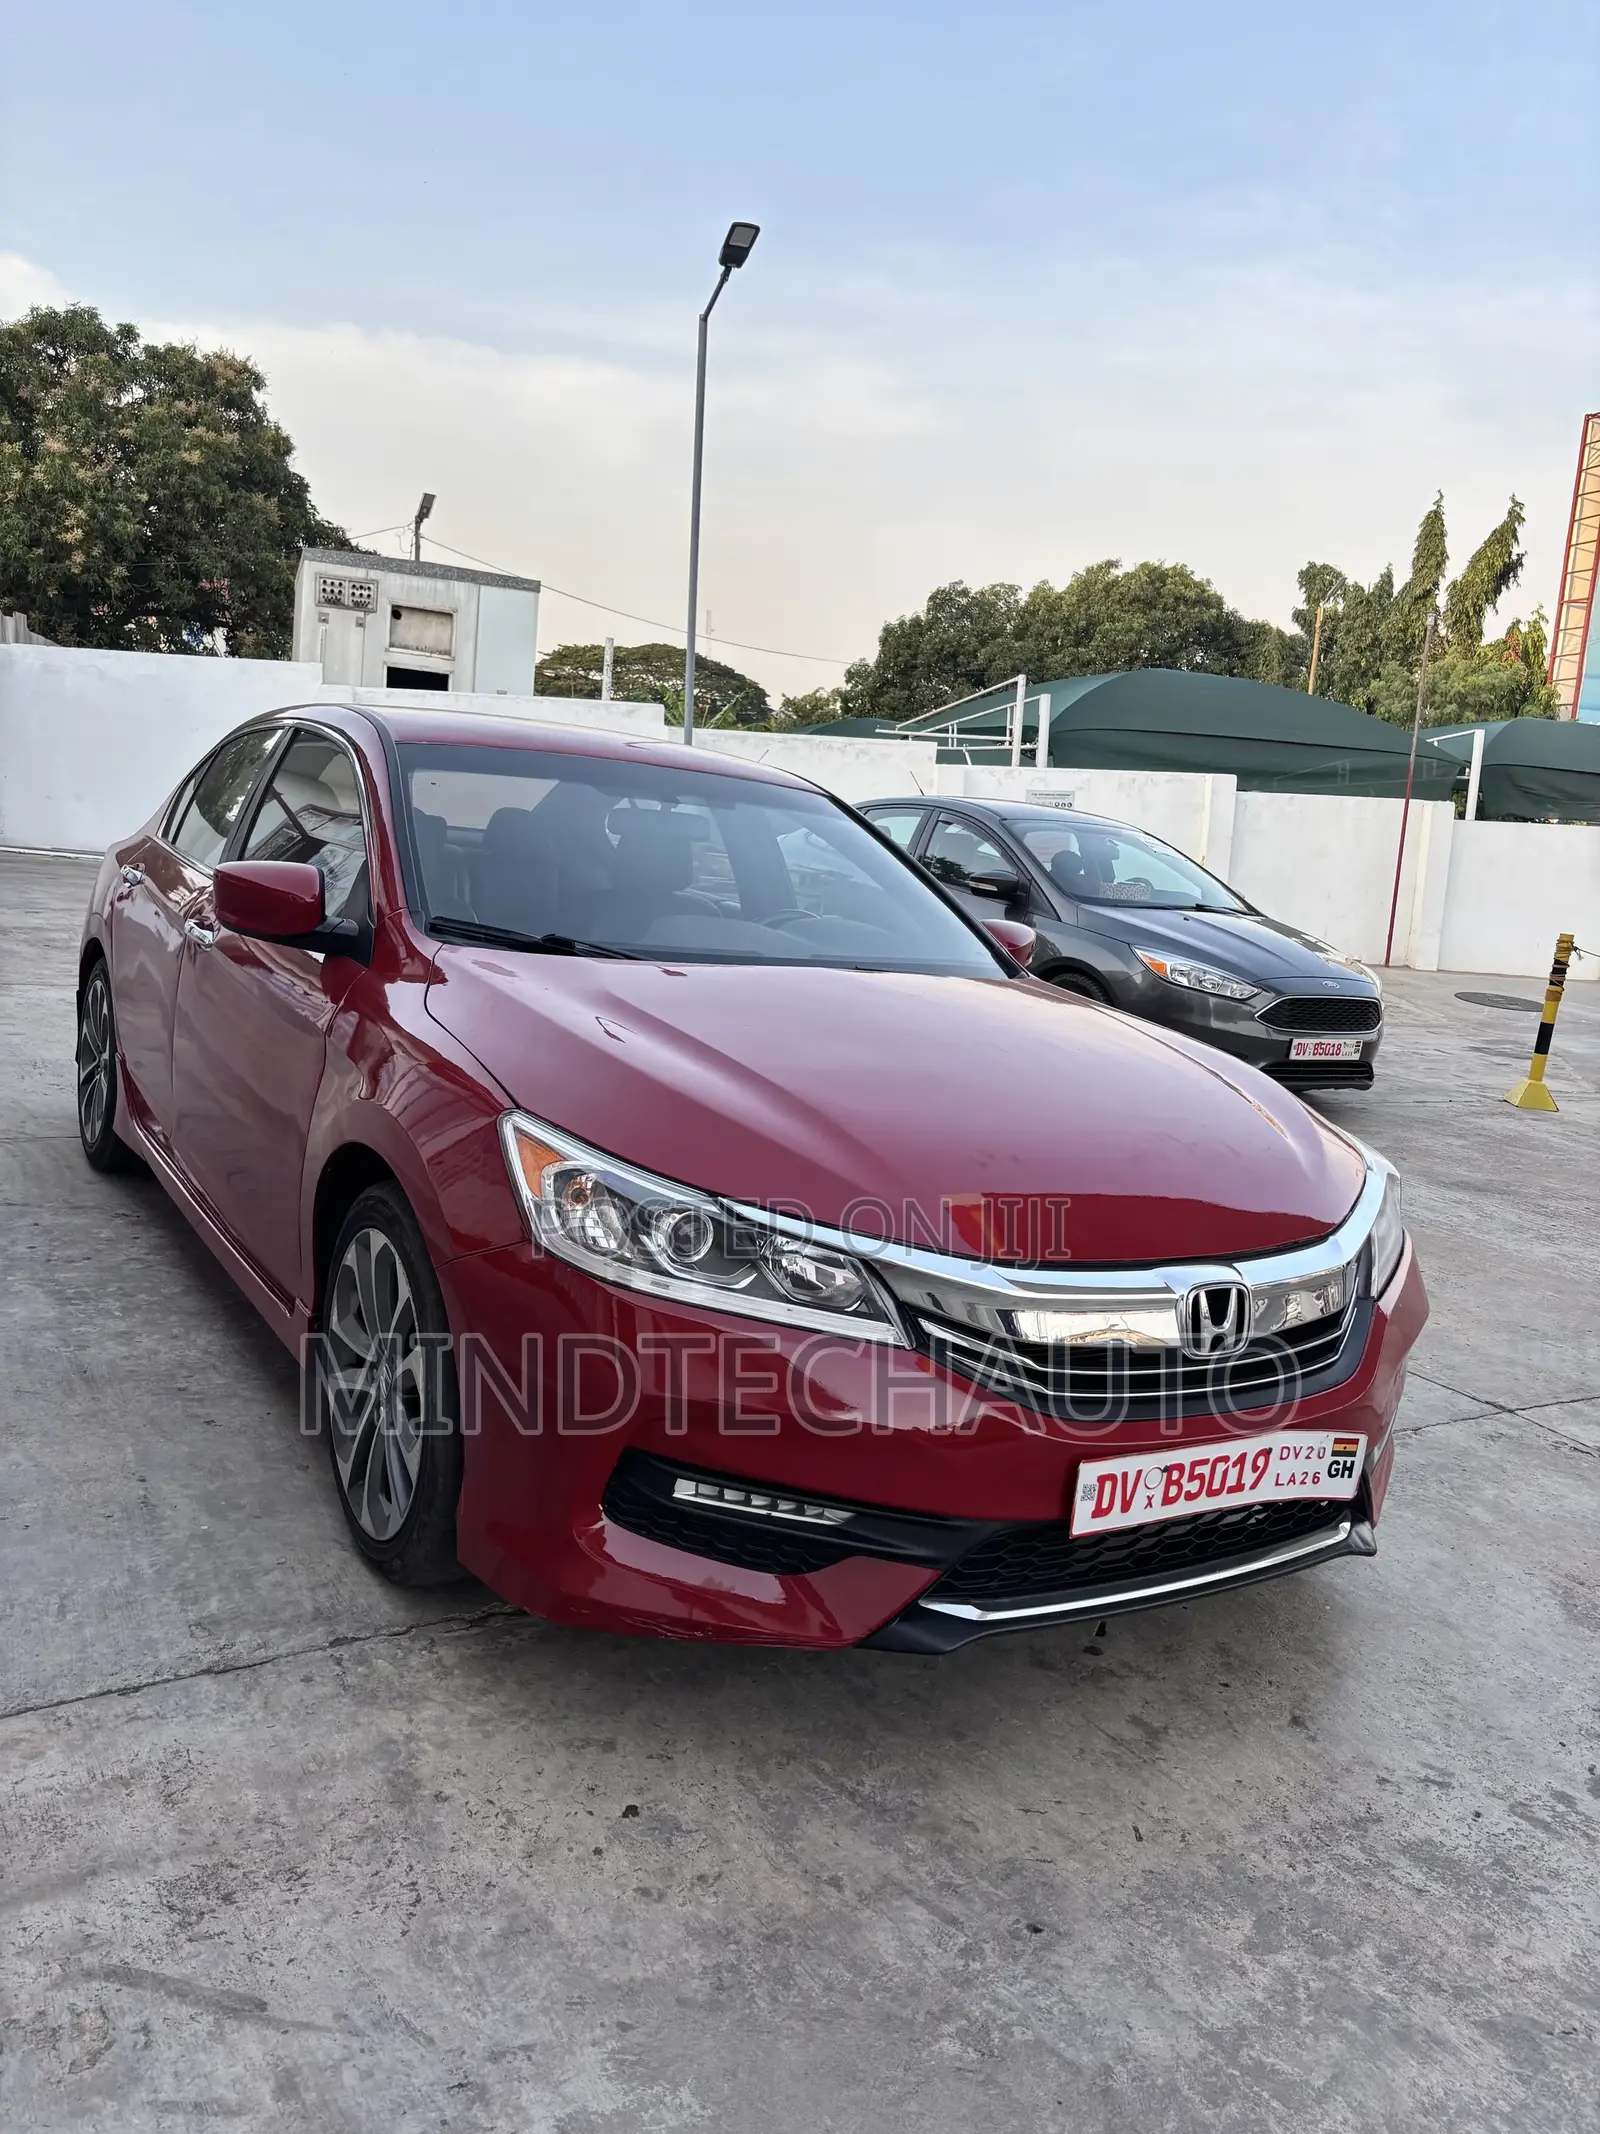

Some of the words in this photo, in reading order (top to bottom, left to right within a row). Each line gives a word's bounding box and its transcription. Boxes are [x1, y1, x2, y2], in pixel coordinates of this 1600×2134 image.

[1295, 1042, 1309, 1056] DV
[1312, 1041, 1342, 1056] B5018
[1279, 1444, 1326, 1461] DV20
[1327, 1459, 1355, 1479] GH
[1091, 1468, 1143, 1519] DV
[1161, 1447, 1271, 1506] B5019
[1274, 1471, 1321, 1487] LA26
